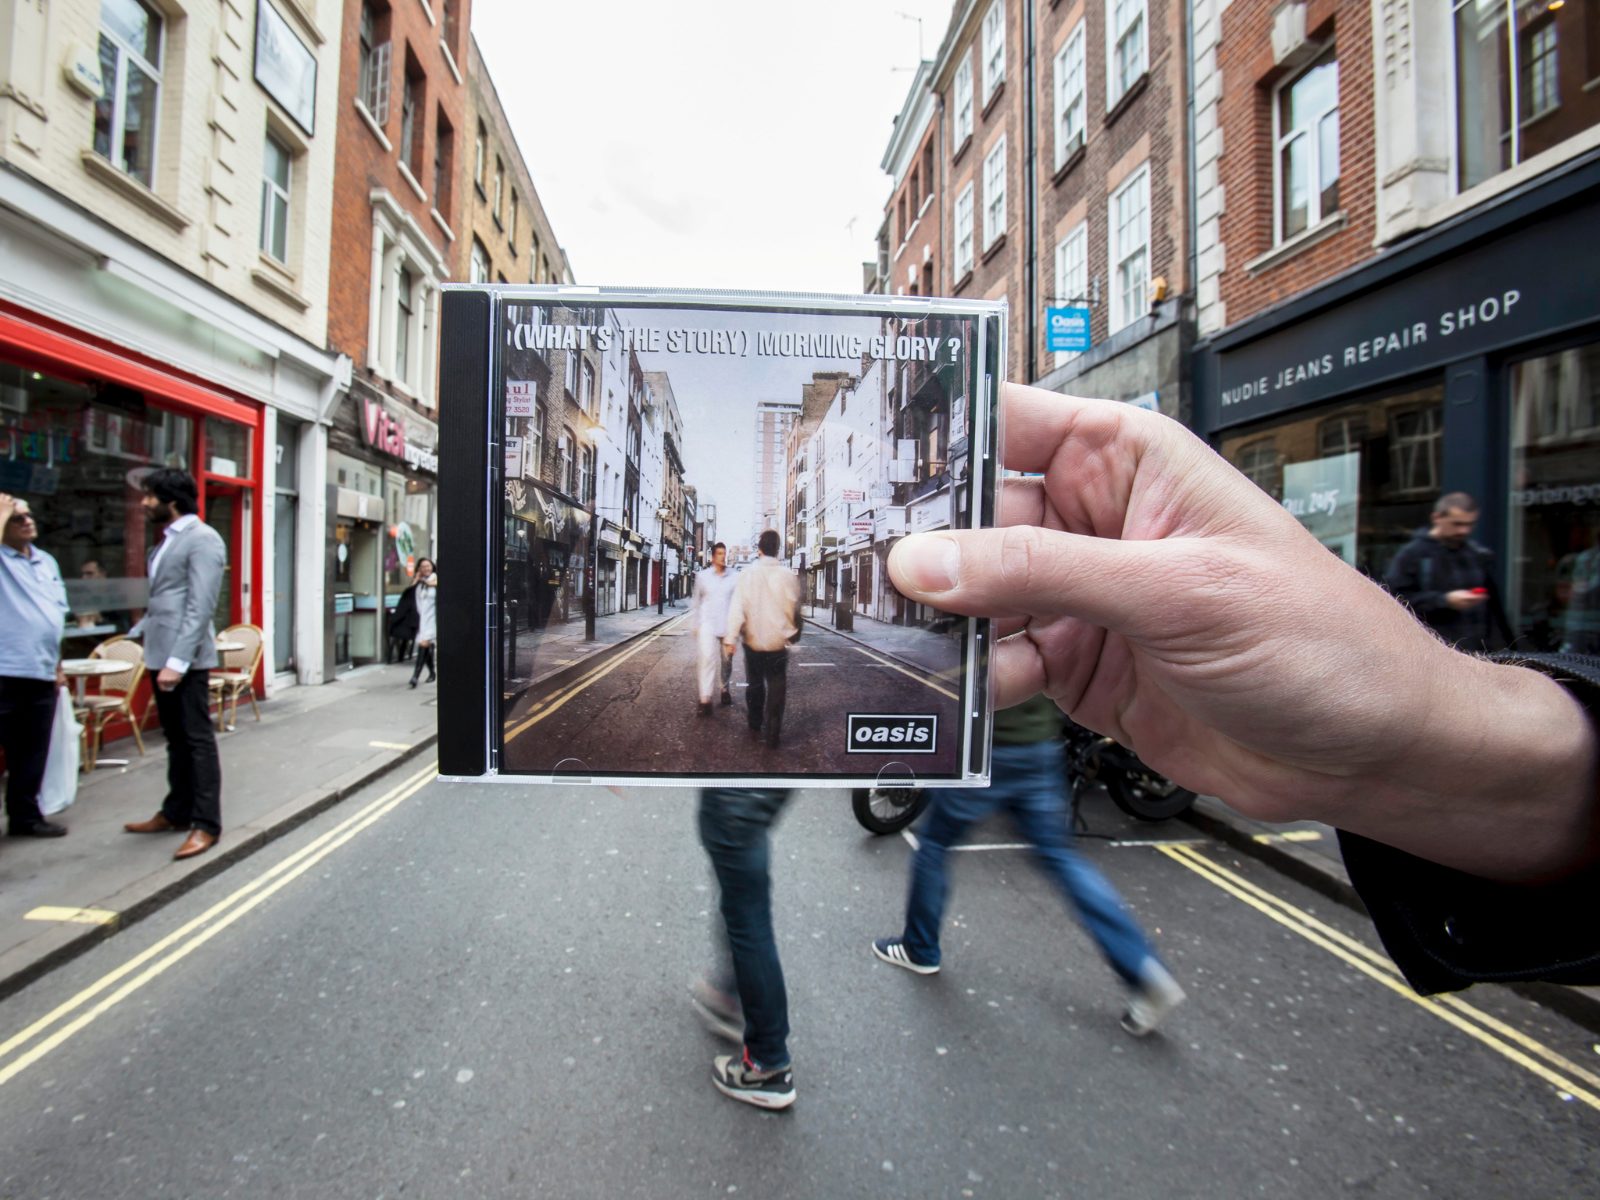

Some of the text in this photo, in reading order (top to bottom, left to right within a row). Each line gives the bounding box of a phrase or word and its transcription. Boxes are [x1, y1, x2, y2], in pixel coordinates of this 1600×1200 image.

[1051, 314, 1086, 328] Oasis
[619, 326, 661, 353] THE
[666, 327, 748, 357] STORY)
[757, 331, 862, 360] MORNING
[869, 335, 940, 361] GLORY
[1221, 289, 1521, 407] NUDIE JEANS REPAIR SHOP
[362, 398, 405, 459] Vital
[855, 721, 929, 743] oasis
